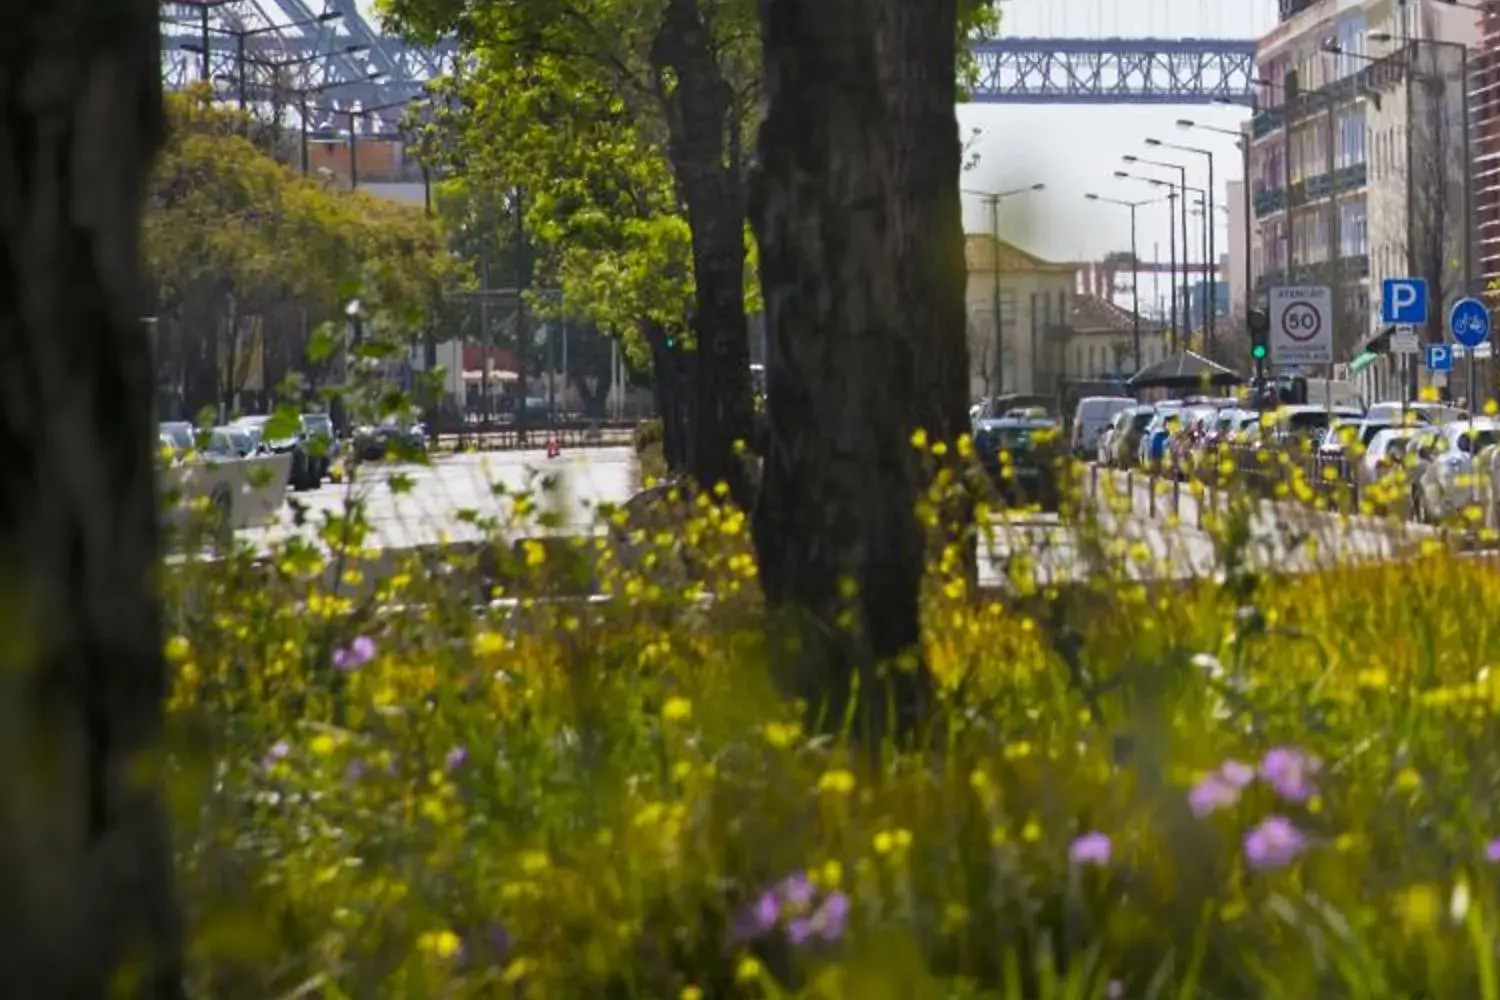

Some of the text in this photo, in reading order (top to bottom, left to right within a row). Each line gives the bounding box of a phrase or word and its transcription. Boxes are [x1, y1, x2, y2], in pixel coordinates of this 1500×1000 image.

[1391, 283, 1417, 319] P
[1289, 312, 1315, 330] 50
[1431, 347, 1446, 368] P
